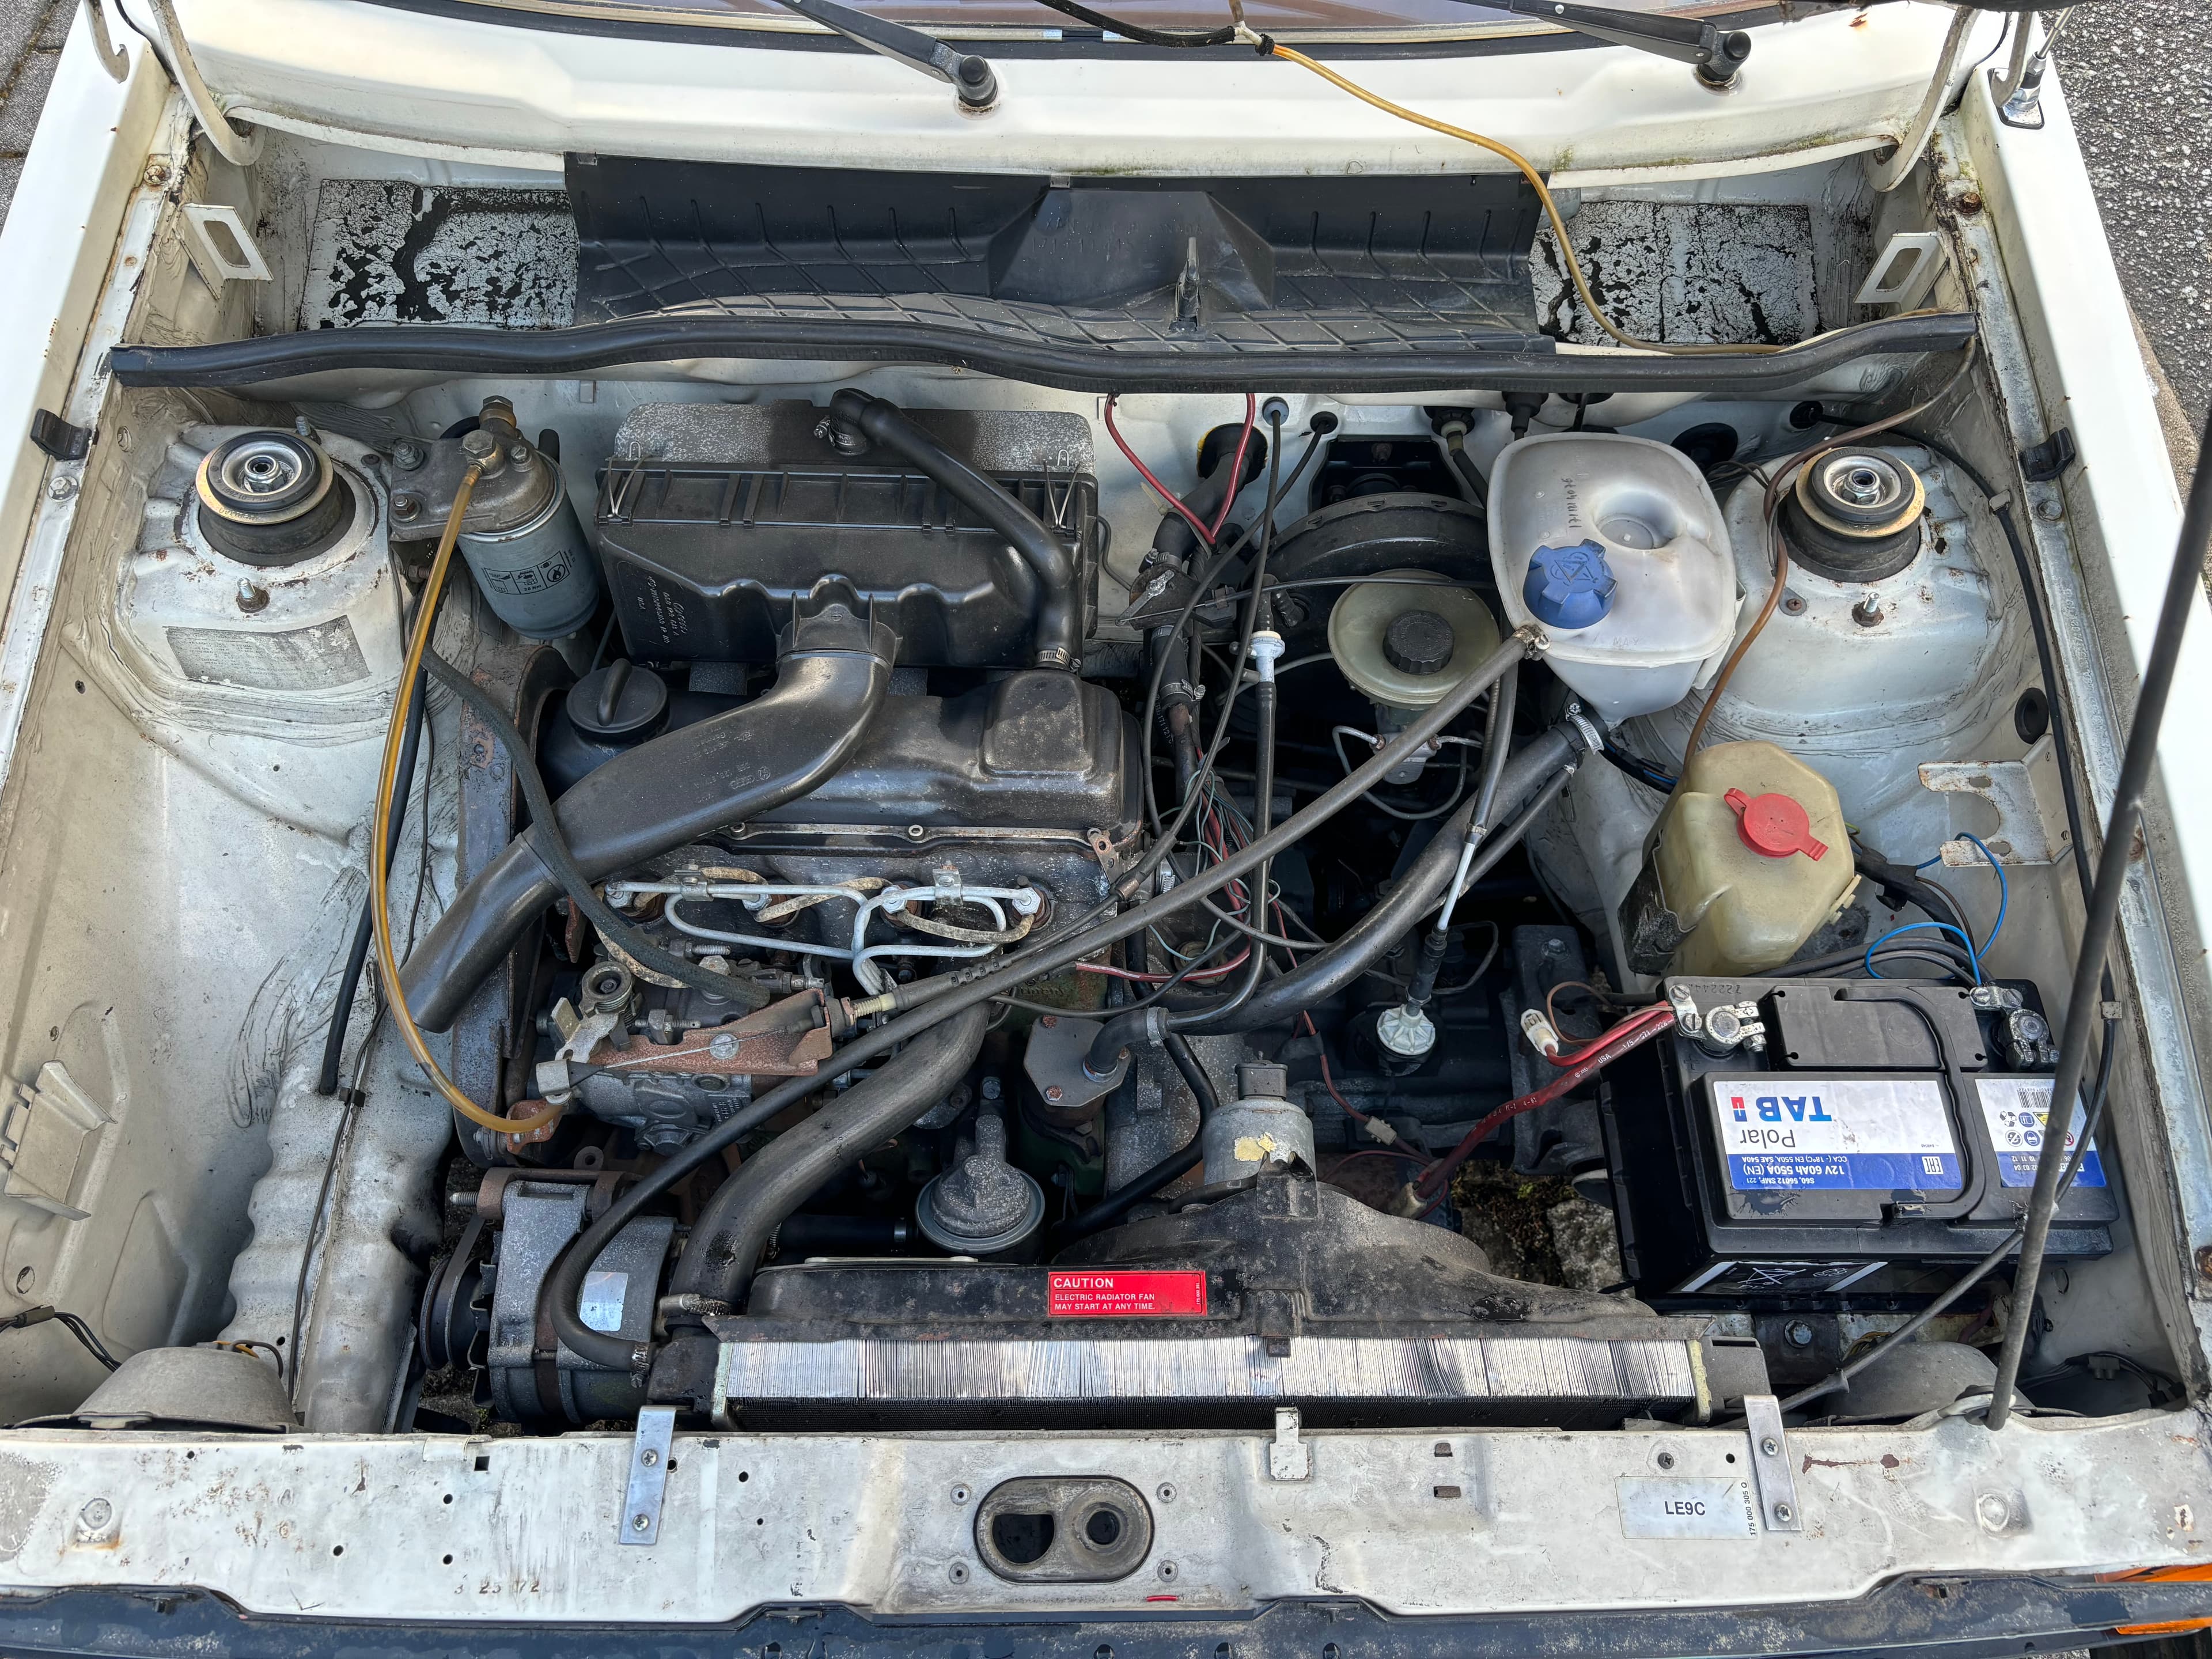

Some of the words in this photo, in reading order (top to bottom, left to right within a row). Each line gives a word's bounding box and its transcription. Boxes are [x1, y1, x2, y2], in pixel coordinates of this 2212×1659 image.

[1597, 1053, 1612, 1064] USA
[1755, 1096, 1832, 1122] TAB
[1740, 1129, 1796, 1149] Polar
[1743, 1164, 1766, 1176] (EN)
[1767, 1165, 1793, 1175] 550A
[1794, 1165, 1823, 1175] 60Ah
[1824, 1165, 1844, 1175] 12V
[1798, 1176, 1815, 1184] S60,
[1053, 1277, 1114, 1289] CAUTION
[1664, 1501, 1706, 1516] LE9C
[1746, 1506, 1754, 1521] 000
[1749, 1522, 1757, 1536] 175
